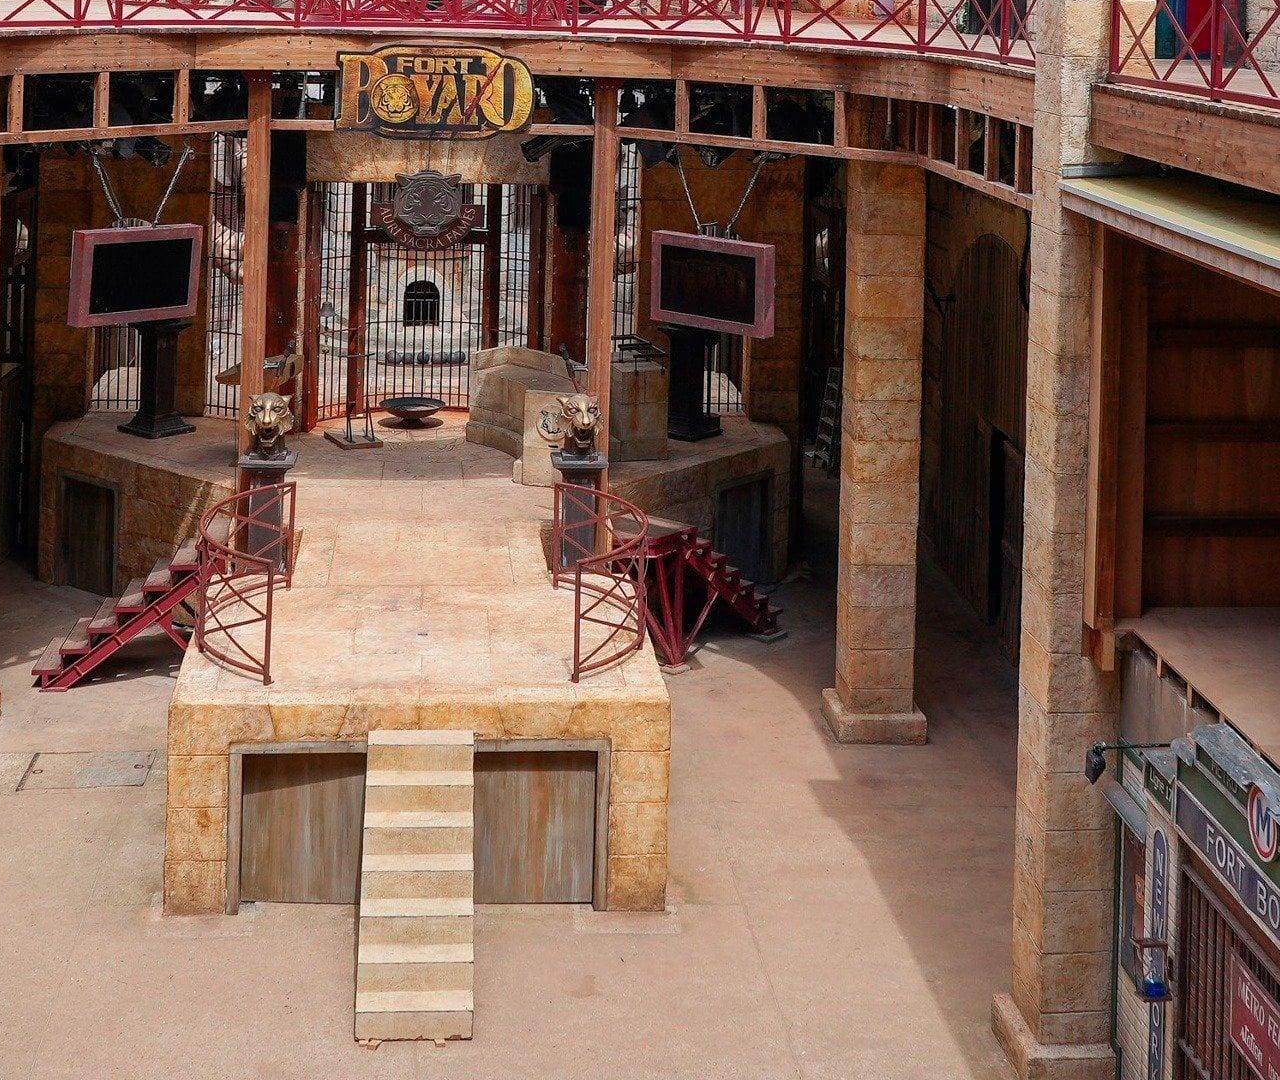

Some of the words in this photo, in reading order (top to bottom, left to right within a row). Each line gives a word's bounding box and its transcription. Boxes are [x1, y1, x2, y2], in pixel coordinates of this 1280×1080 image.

[396, 56, 473, 73] FORT
[380, 206, 402, 236] AURI
[402, 233, 445, 250] SACRA
[446, 206, 476, 243] FAMES
[1256, 797, 1272, 849] M
[1205, 823, 1247, 892] FORT
[1150, 988, 1161, 1080] ORK
